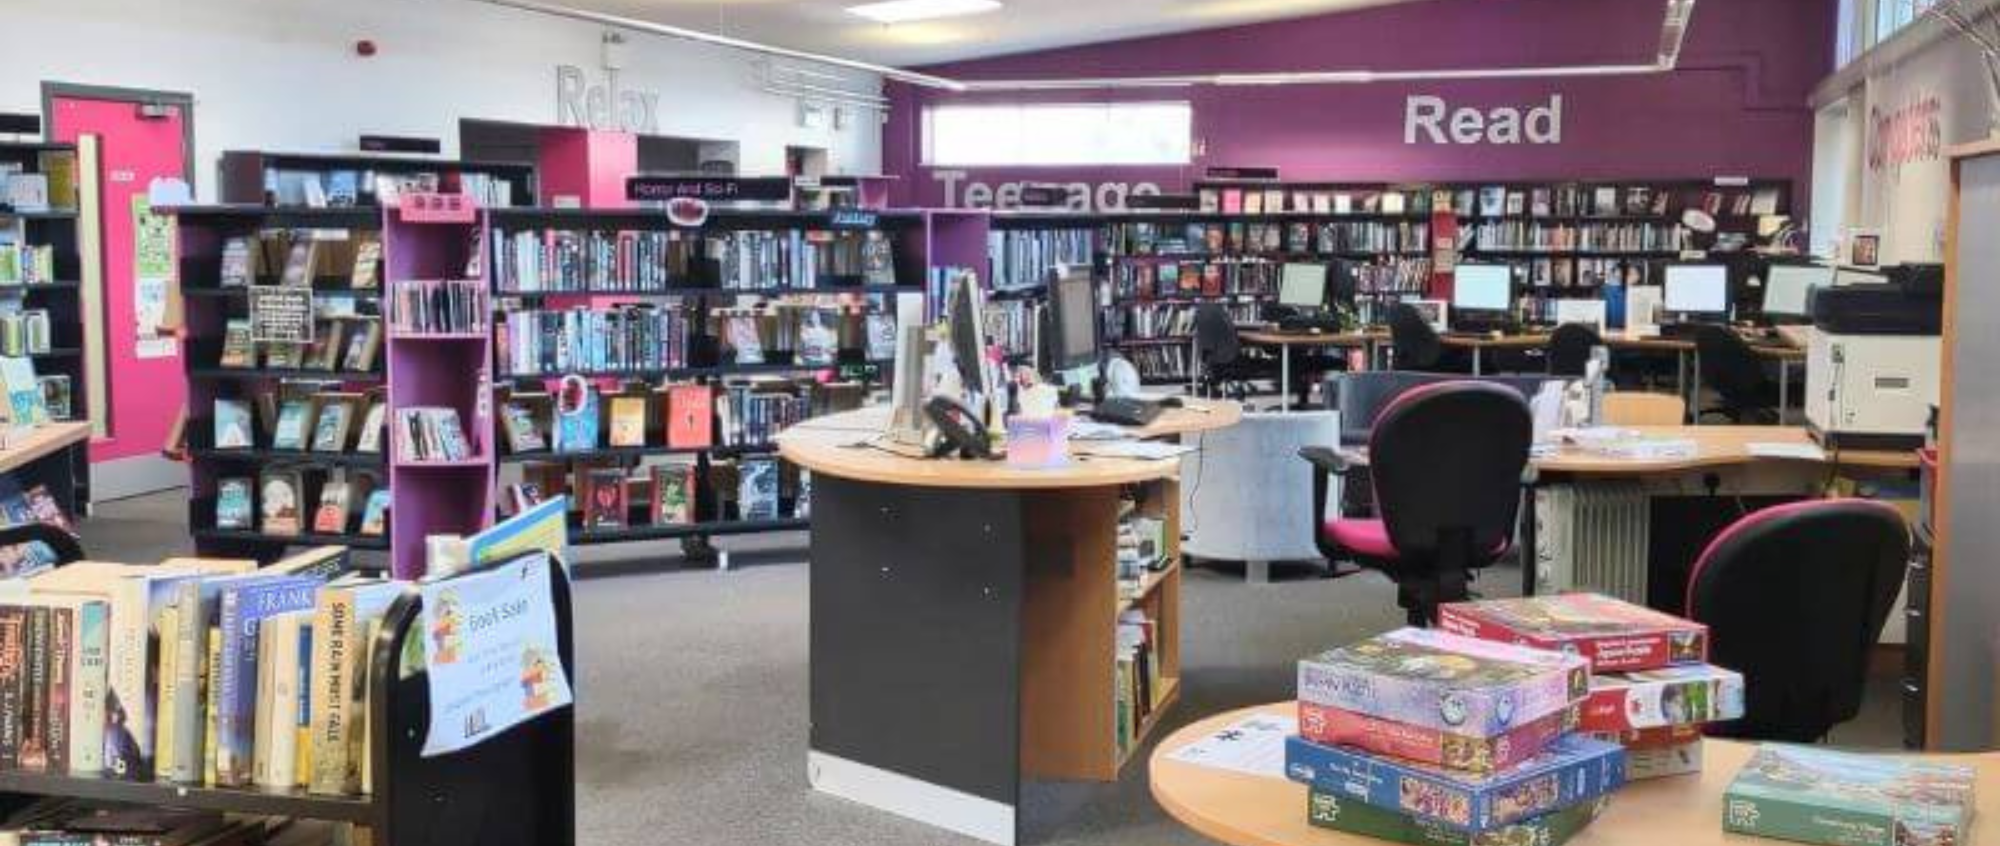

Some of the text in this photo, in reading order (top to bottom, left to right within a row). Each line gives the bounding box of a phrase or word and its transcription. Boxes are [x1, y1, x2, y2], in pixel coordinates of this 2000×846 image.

[556, 64, 661, 132] Relax
[1404, 94, 1562, 144] Read
[932, 169, 1162, 213] Teeage
[260, 588, 312, 613] FRANK
[332, 602, 347, 637] SOME
